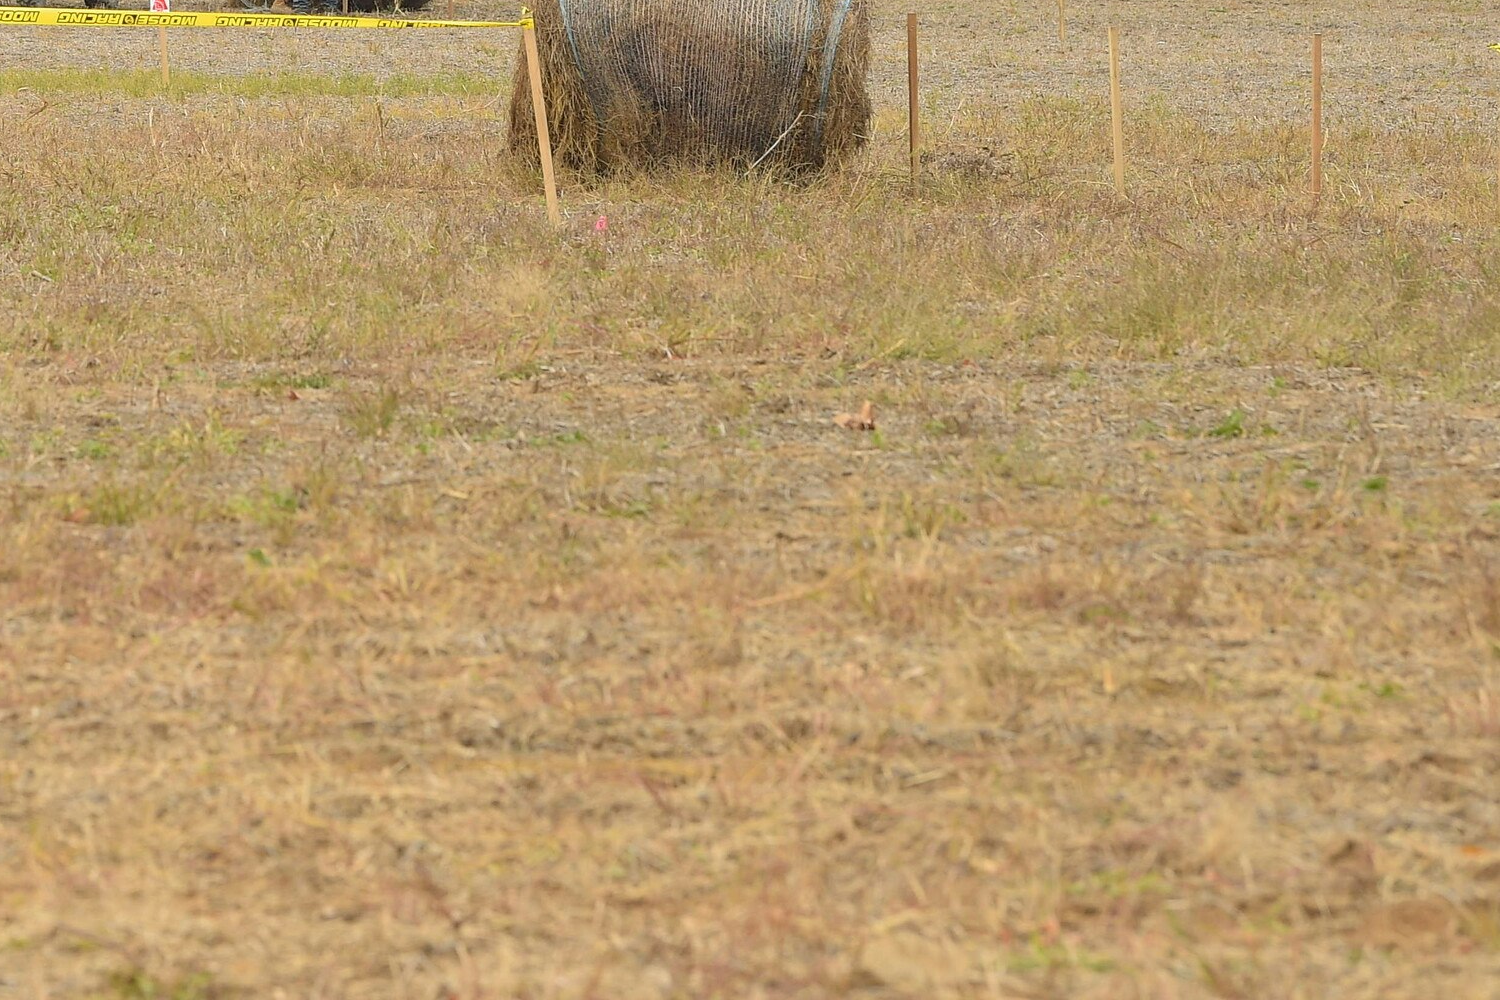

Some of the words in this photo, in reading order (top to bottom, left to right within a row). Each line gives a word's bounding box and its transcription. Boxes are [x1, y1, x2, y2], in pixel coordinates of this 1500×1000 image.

[58, 12, 121, 24] RACING
[136, 14, 197, 26] MOOSE
[216, 16, 280, 27] RACING
[296, 18, 358, 28] MOOSE
